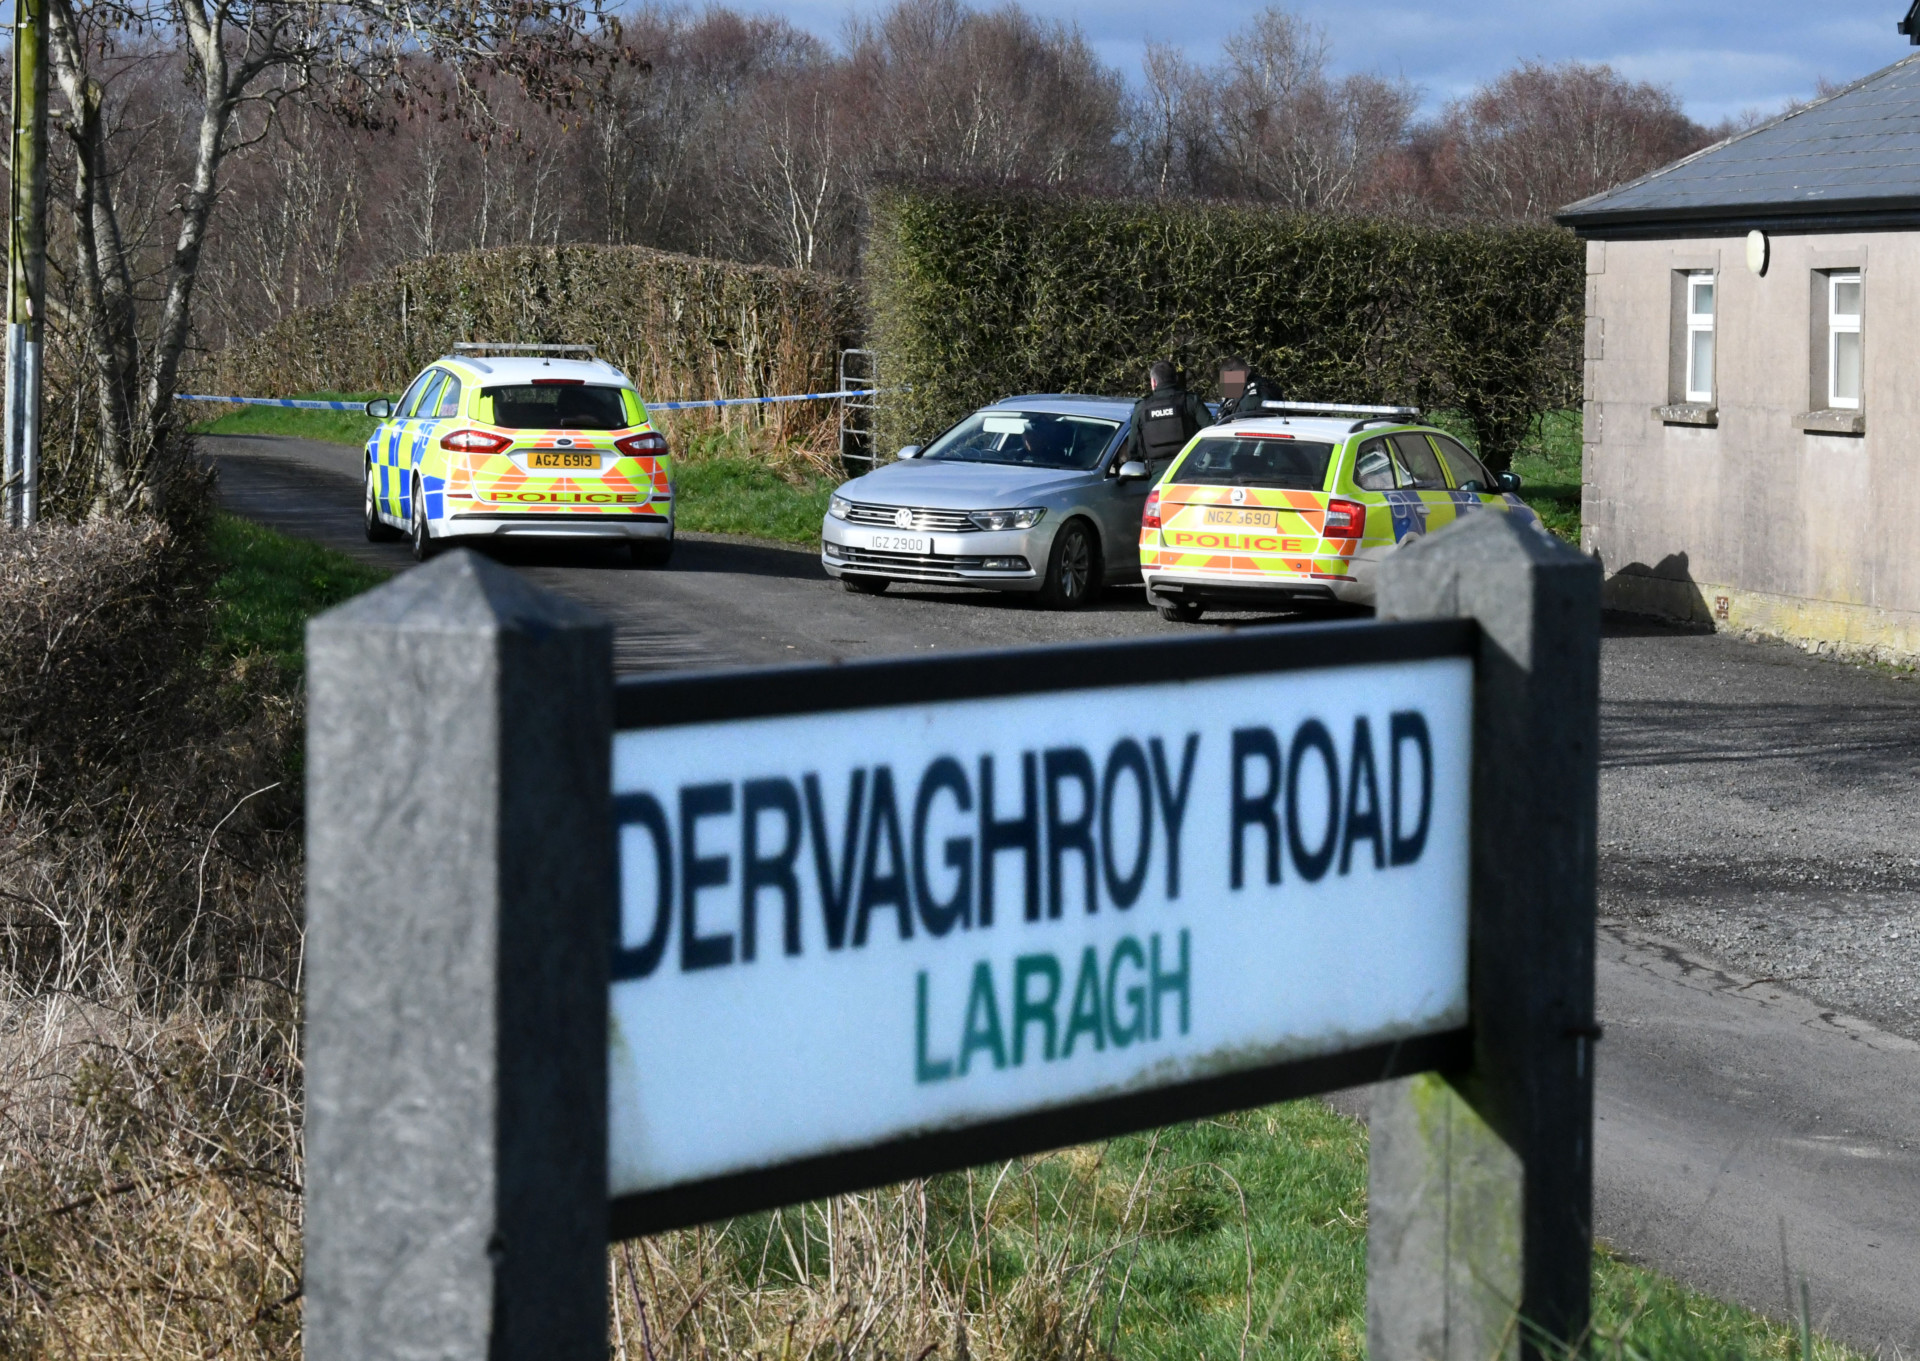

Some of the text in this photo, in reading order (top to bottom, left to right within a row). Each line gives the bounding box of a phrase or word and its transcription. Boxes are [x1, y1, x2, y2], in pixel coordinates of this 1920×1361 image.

[1151, 407, 1174, 418] POLICE
[535, 454, 593, 467] AGZ 6913
[490, 492, 638, 503] POLICE
[1207, 510, 1233, 524] NGZ
[872, 535, 923, 551] IGZ 2900
[1175, 533, 1302, 552] POLICE
[611, 709, 1434, 984] DERVAGHROY ROAD
[914, 928, 1192, 1086] LARAGH
